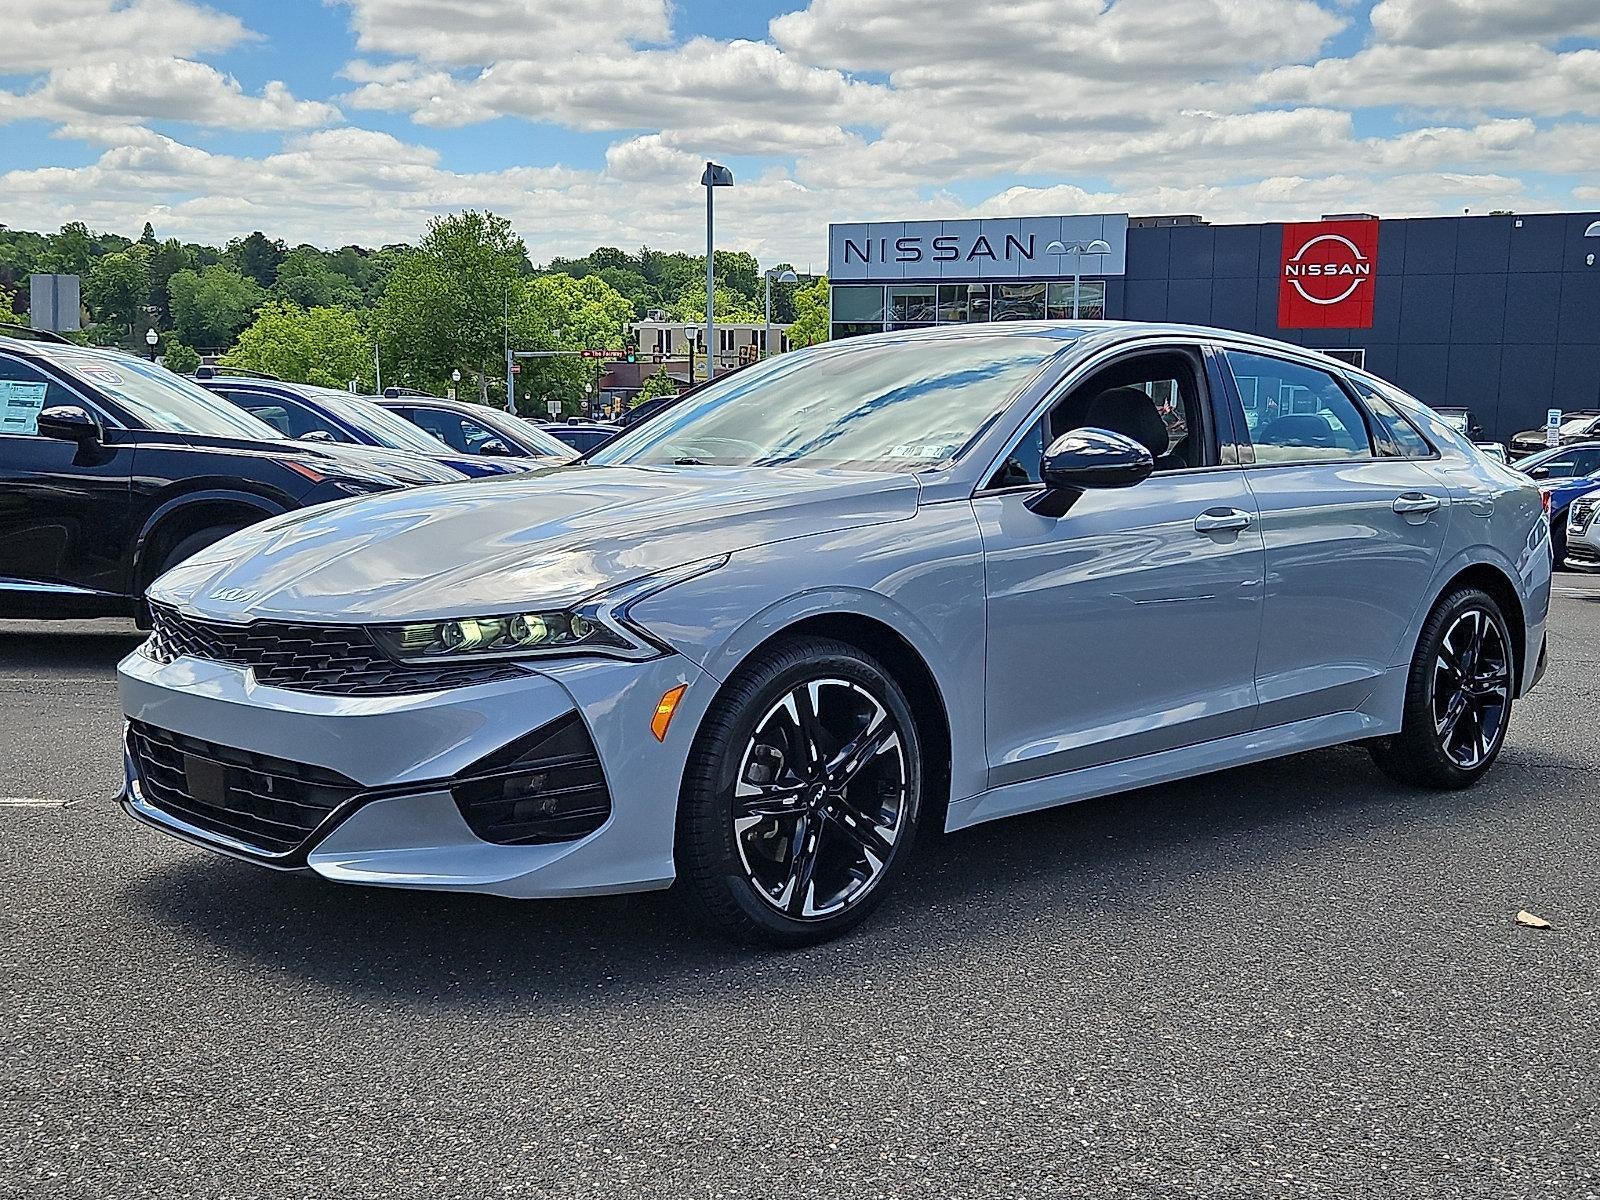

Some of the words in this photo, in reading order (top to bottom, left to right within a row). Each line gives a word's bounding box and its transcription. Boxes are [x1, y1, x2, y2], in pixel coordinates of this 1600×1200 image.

[844, 233, 1036, 263] NISSAN
[1285, 263, 1370, 276] NISSAN
[209, 587, 258, 602] KIA
